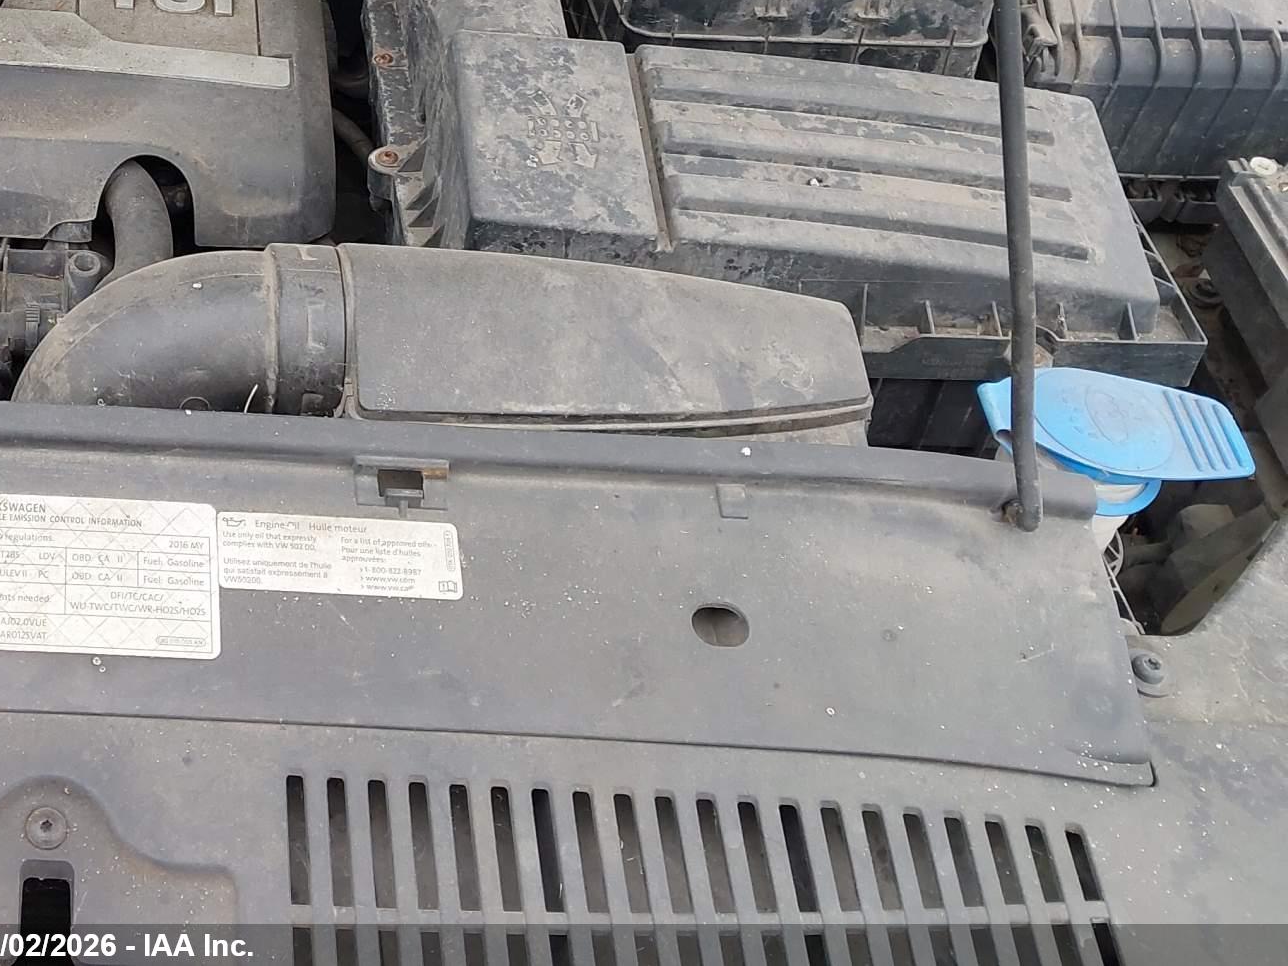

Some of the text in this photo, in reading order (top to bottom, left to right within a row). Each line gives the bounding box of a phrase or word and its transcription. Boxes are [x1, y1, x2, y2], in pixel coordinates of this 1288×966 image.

[9, 514, 46, 523] EMISSION
[50, 515, 85, 525] CONTROL
[89, 517, 142, 527] INFORMATION
[254, 520, 288, 531] Engine
[334, 524, 367, 534] moteur
[168, 540, 189, 550] 2016
[167, 558, 205, 569] Gasoline
[167, 576, 205, 587] Gasoline
